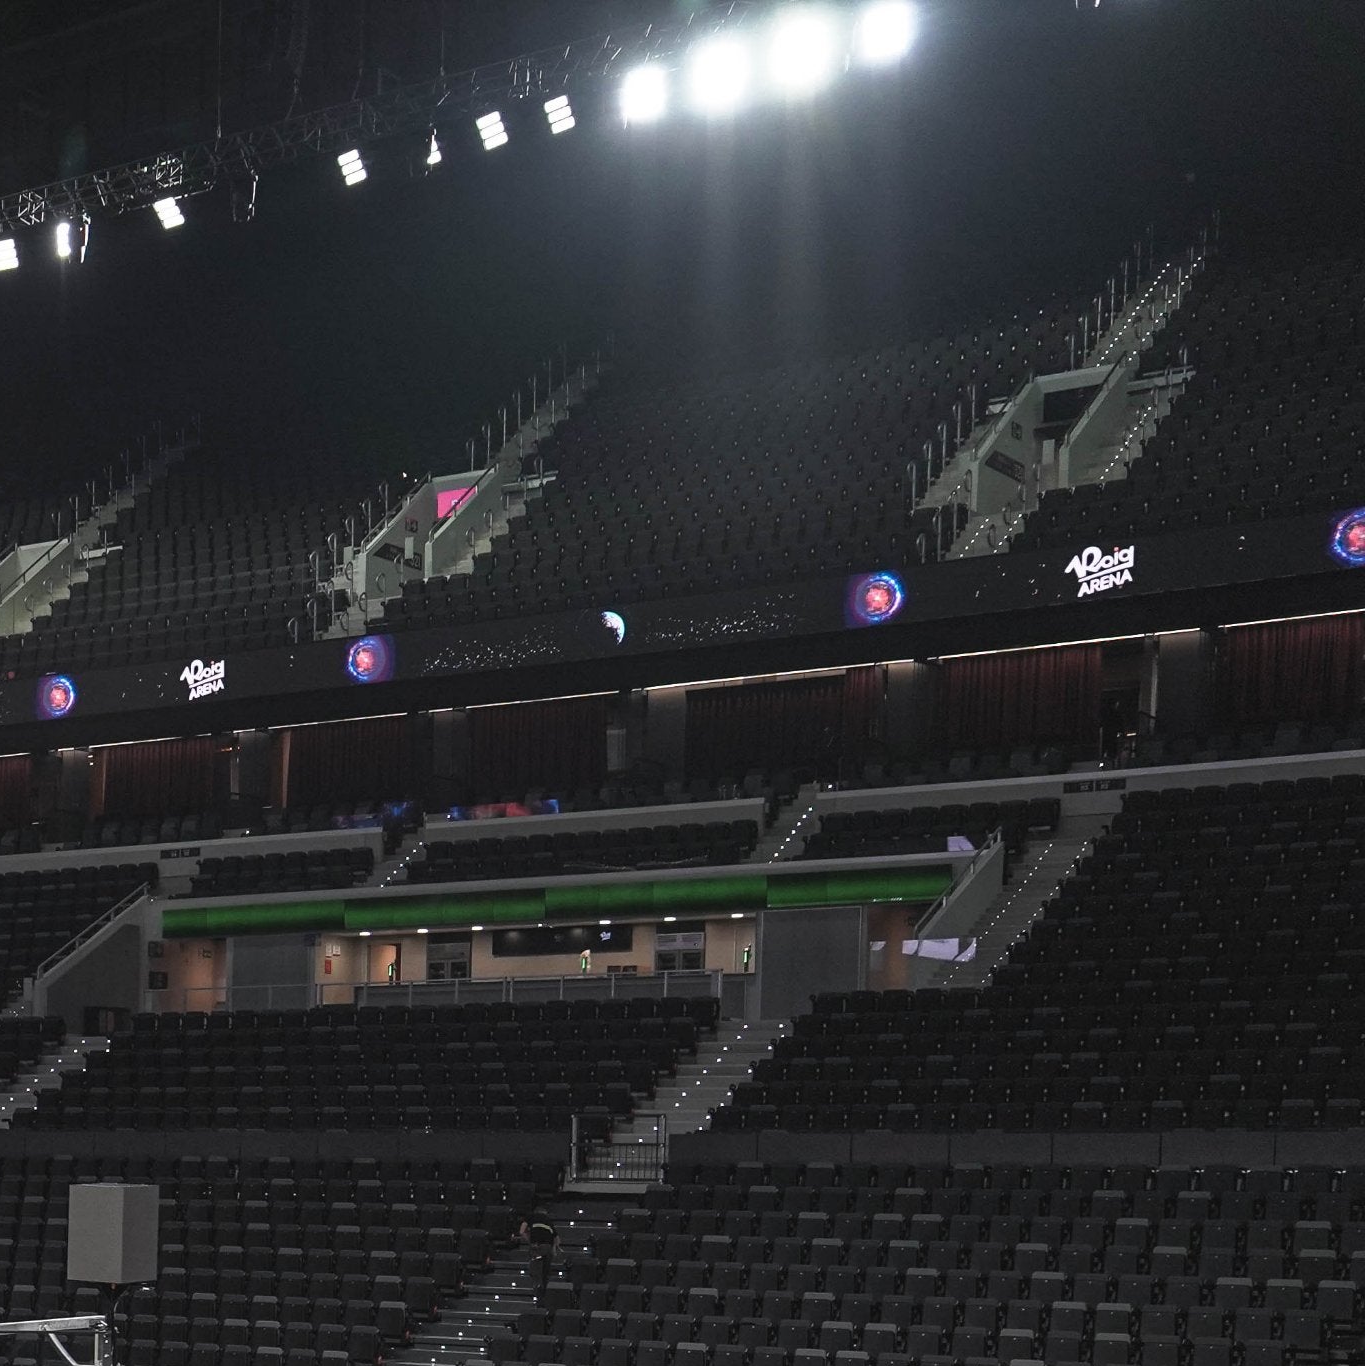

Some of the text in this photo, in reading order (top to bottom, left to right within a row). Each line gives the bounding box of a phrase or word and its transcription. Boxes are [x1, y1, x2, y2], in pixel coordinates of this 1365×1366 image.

[1064, 545, 1135, 583] Roig
[1077, 568, 1133, 598] ARENA
[179, 659, 225, 689] Roig
[188, 678, 225, 701] ARENA
